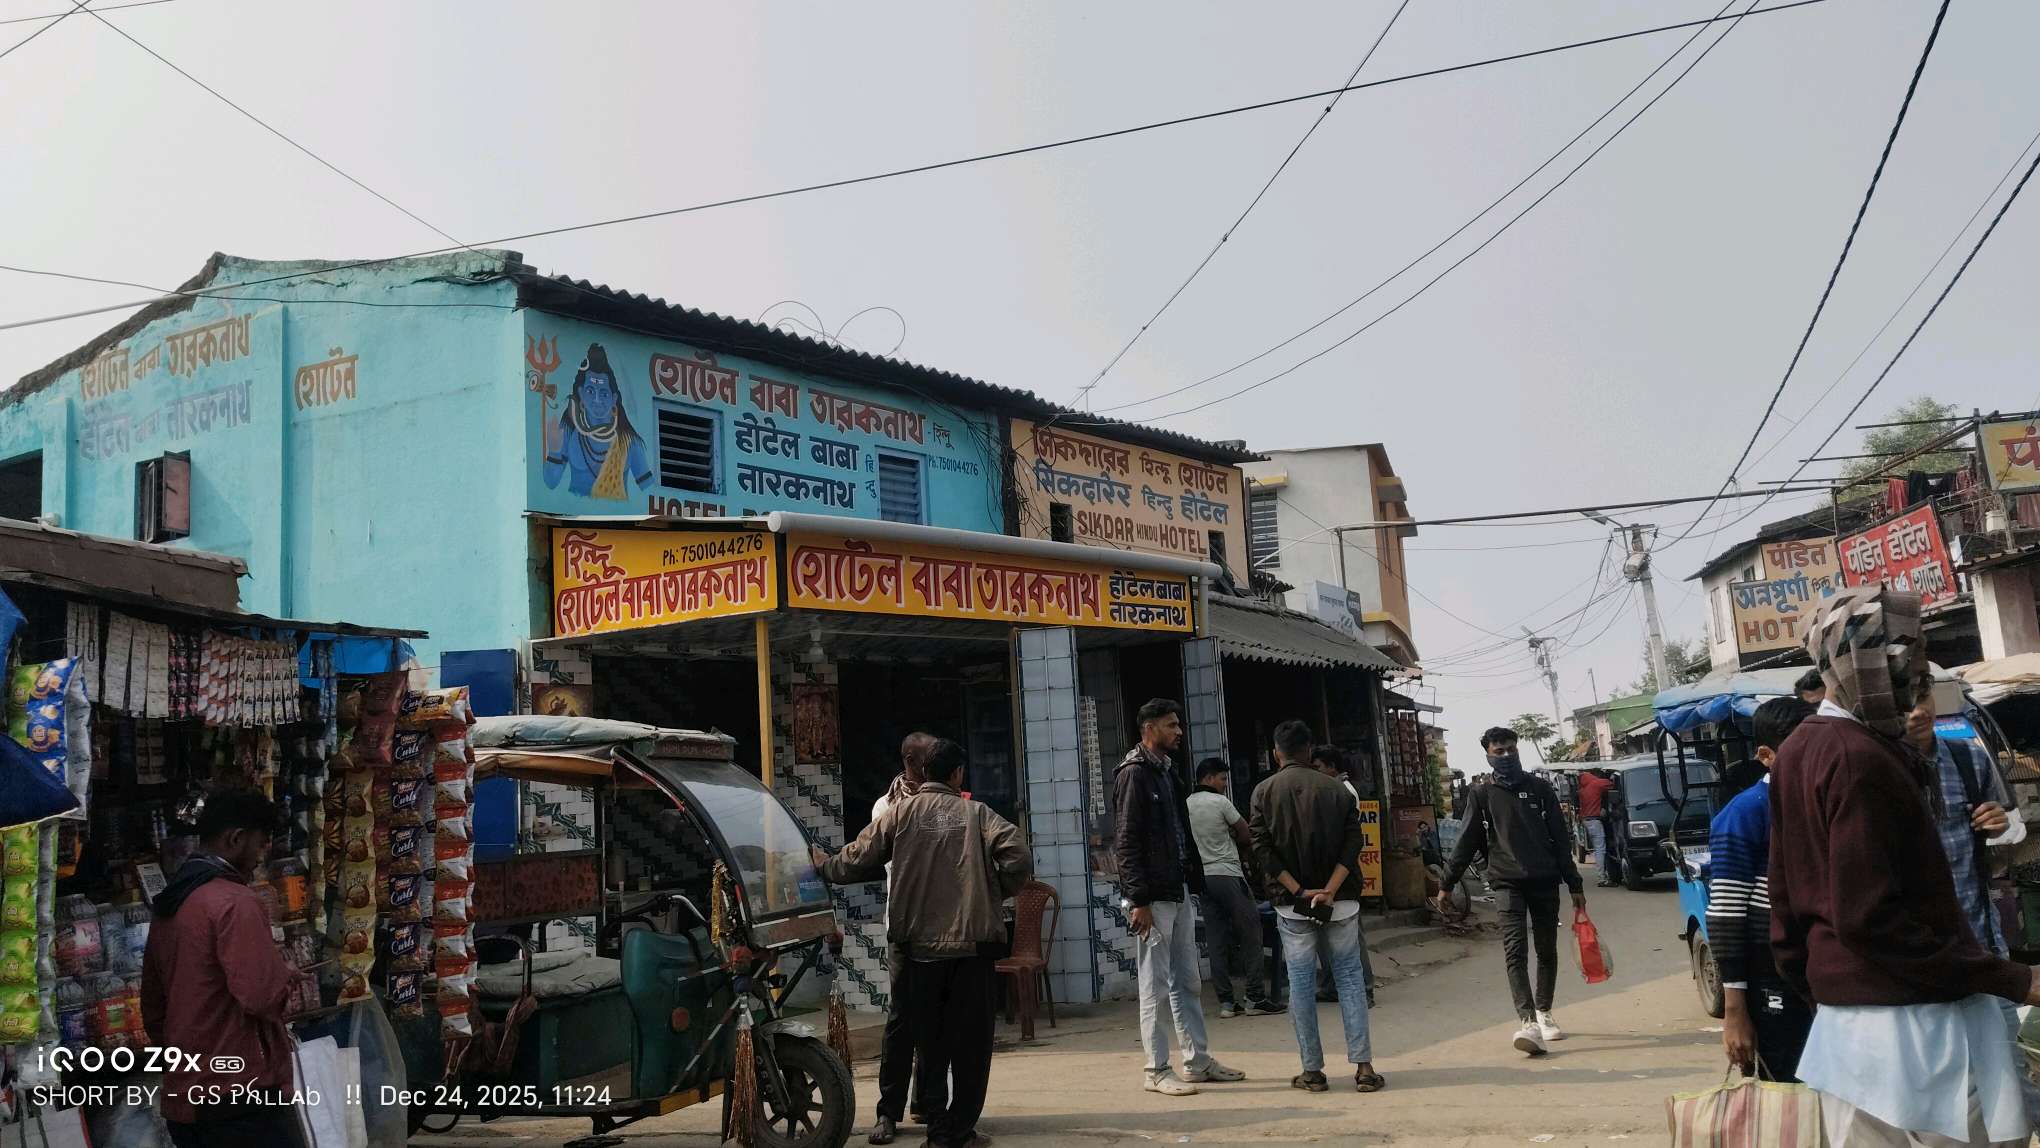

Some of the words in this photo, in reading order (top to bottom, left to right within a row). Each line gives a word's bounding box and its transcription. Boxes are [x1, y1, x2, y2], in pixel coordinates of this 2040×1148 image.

[165, 314, 251, 377] তারকনাথ
[294, 346, 359, 411] হোটেল
[650, 350, 740, 406] হোটেল
[749, 374, 799, 418] বাবা
[808, 387, 927, 445] তারকনাথ
[734, 413, 800, 460] होटेल
[808, 436, 859, 471] बाबा
[736, 462, 857, 510] तारकनाथ
[1178, 463, 1229, 494] হোটেল
[561, 530, 626, 579] হিন্দু
[1077, 510, 1135, 543] SIKDAR
[1136, 522, 1158, 542] HINDU
[1160, 523, 1208, 555] HOTEL
[557, 570, 623, 633] হোটেল
[623, 573, 663, 619] বাবা
[663, 556, 768, 614] তারকনাথ
[792, 539, 904, 604] হোটেল
[910, 555, 975, 611] বাবা
[976, 562, 1102, 618] তারকনাথ
[1109, 570, 1155, 599] होटेल
[1156, 581, 1186, 601] बाबा
[1109, 601, 1187, 626] तारकनाथ
[1742, 615, 1798, 643] HOT
